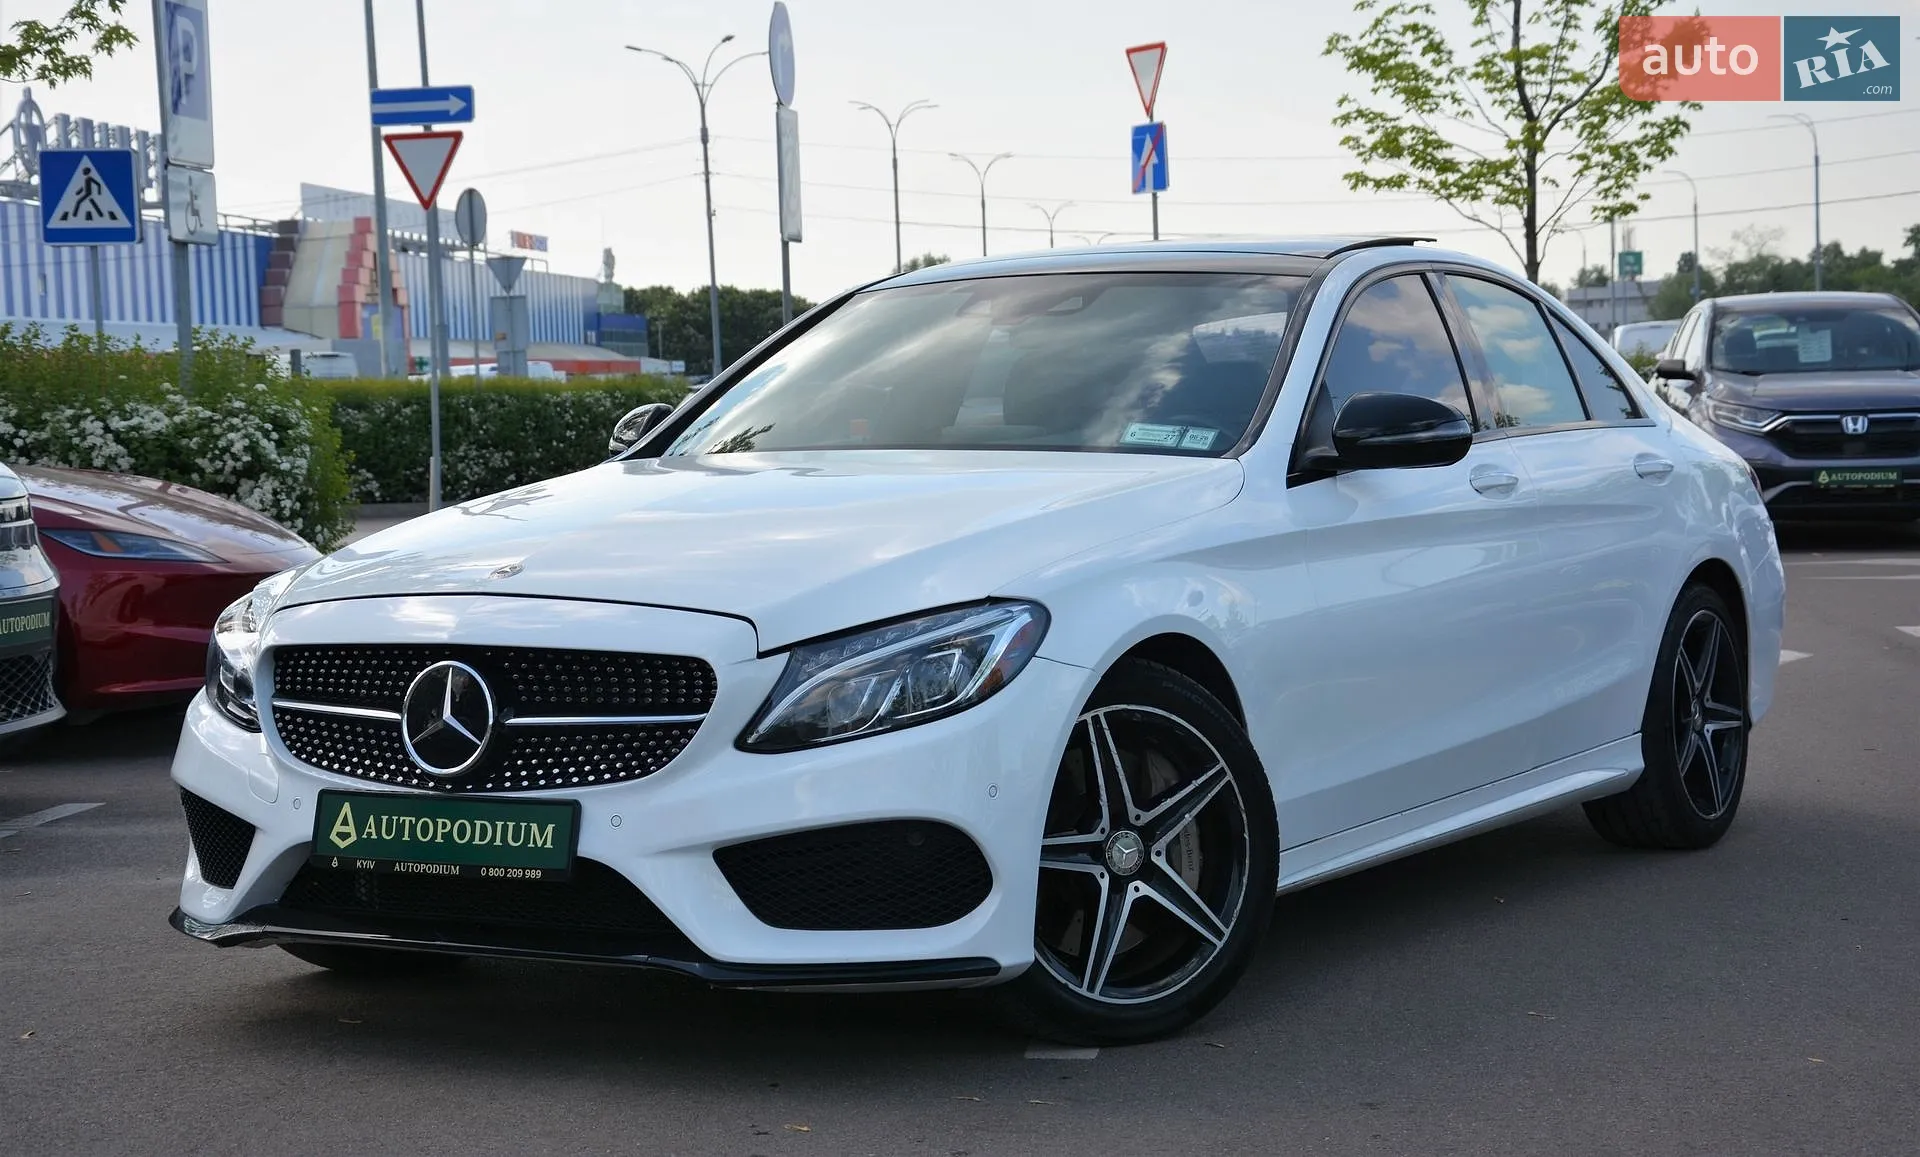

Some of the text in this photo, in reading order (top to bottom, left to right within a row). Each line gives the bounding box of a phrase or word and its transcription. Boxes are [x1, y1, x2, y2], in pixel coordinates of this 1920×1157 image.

[1831, 472, 1897, 480] AUTOPODIUM
[362, 814, 555, 849] AUTOPODIUM
[356, 859, 376, 869] KYIV
[394, 862, 460, 875] AUTOPODIUM
[480, 867, 542, 878] 0 800 209 989
